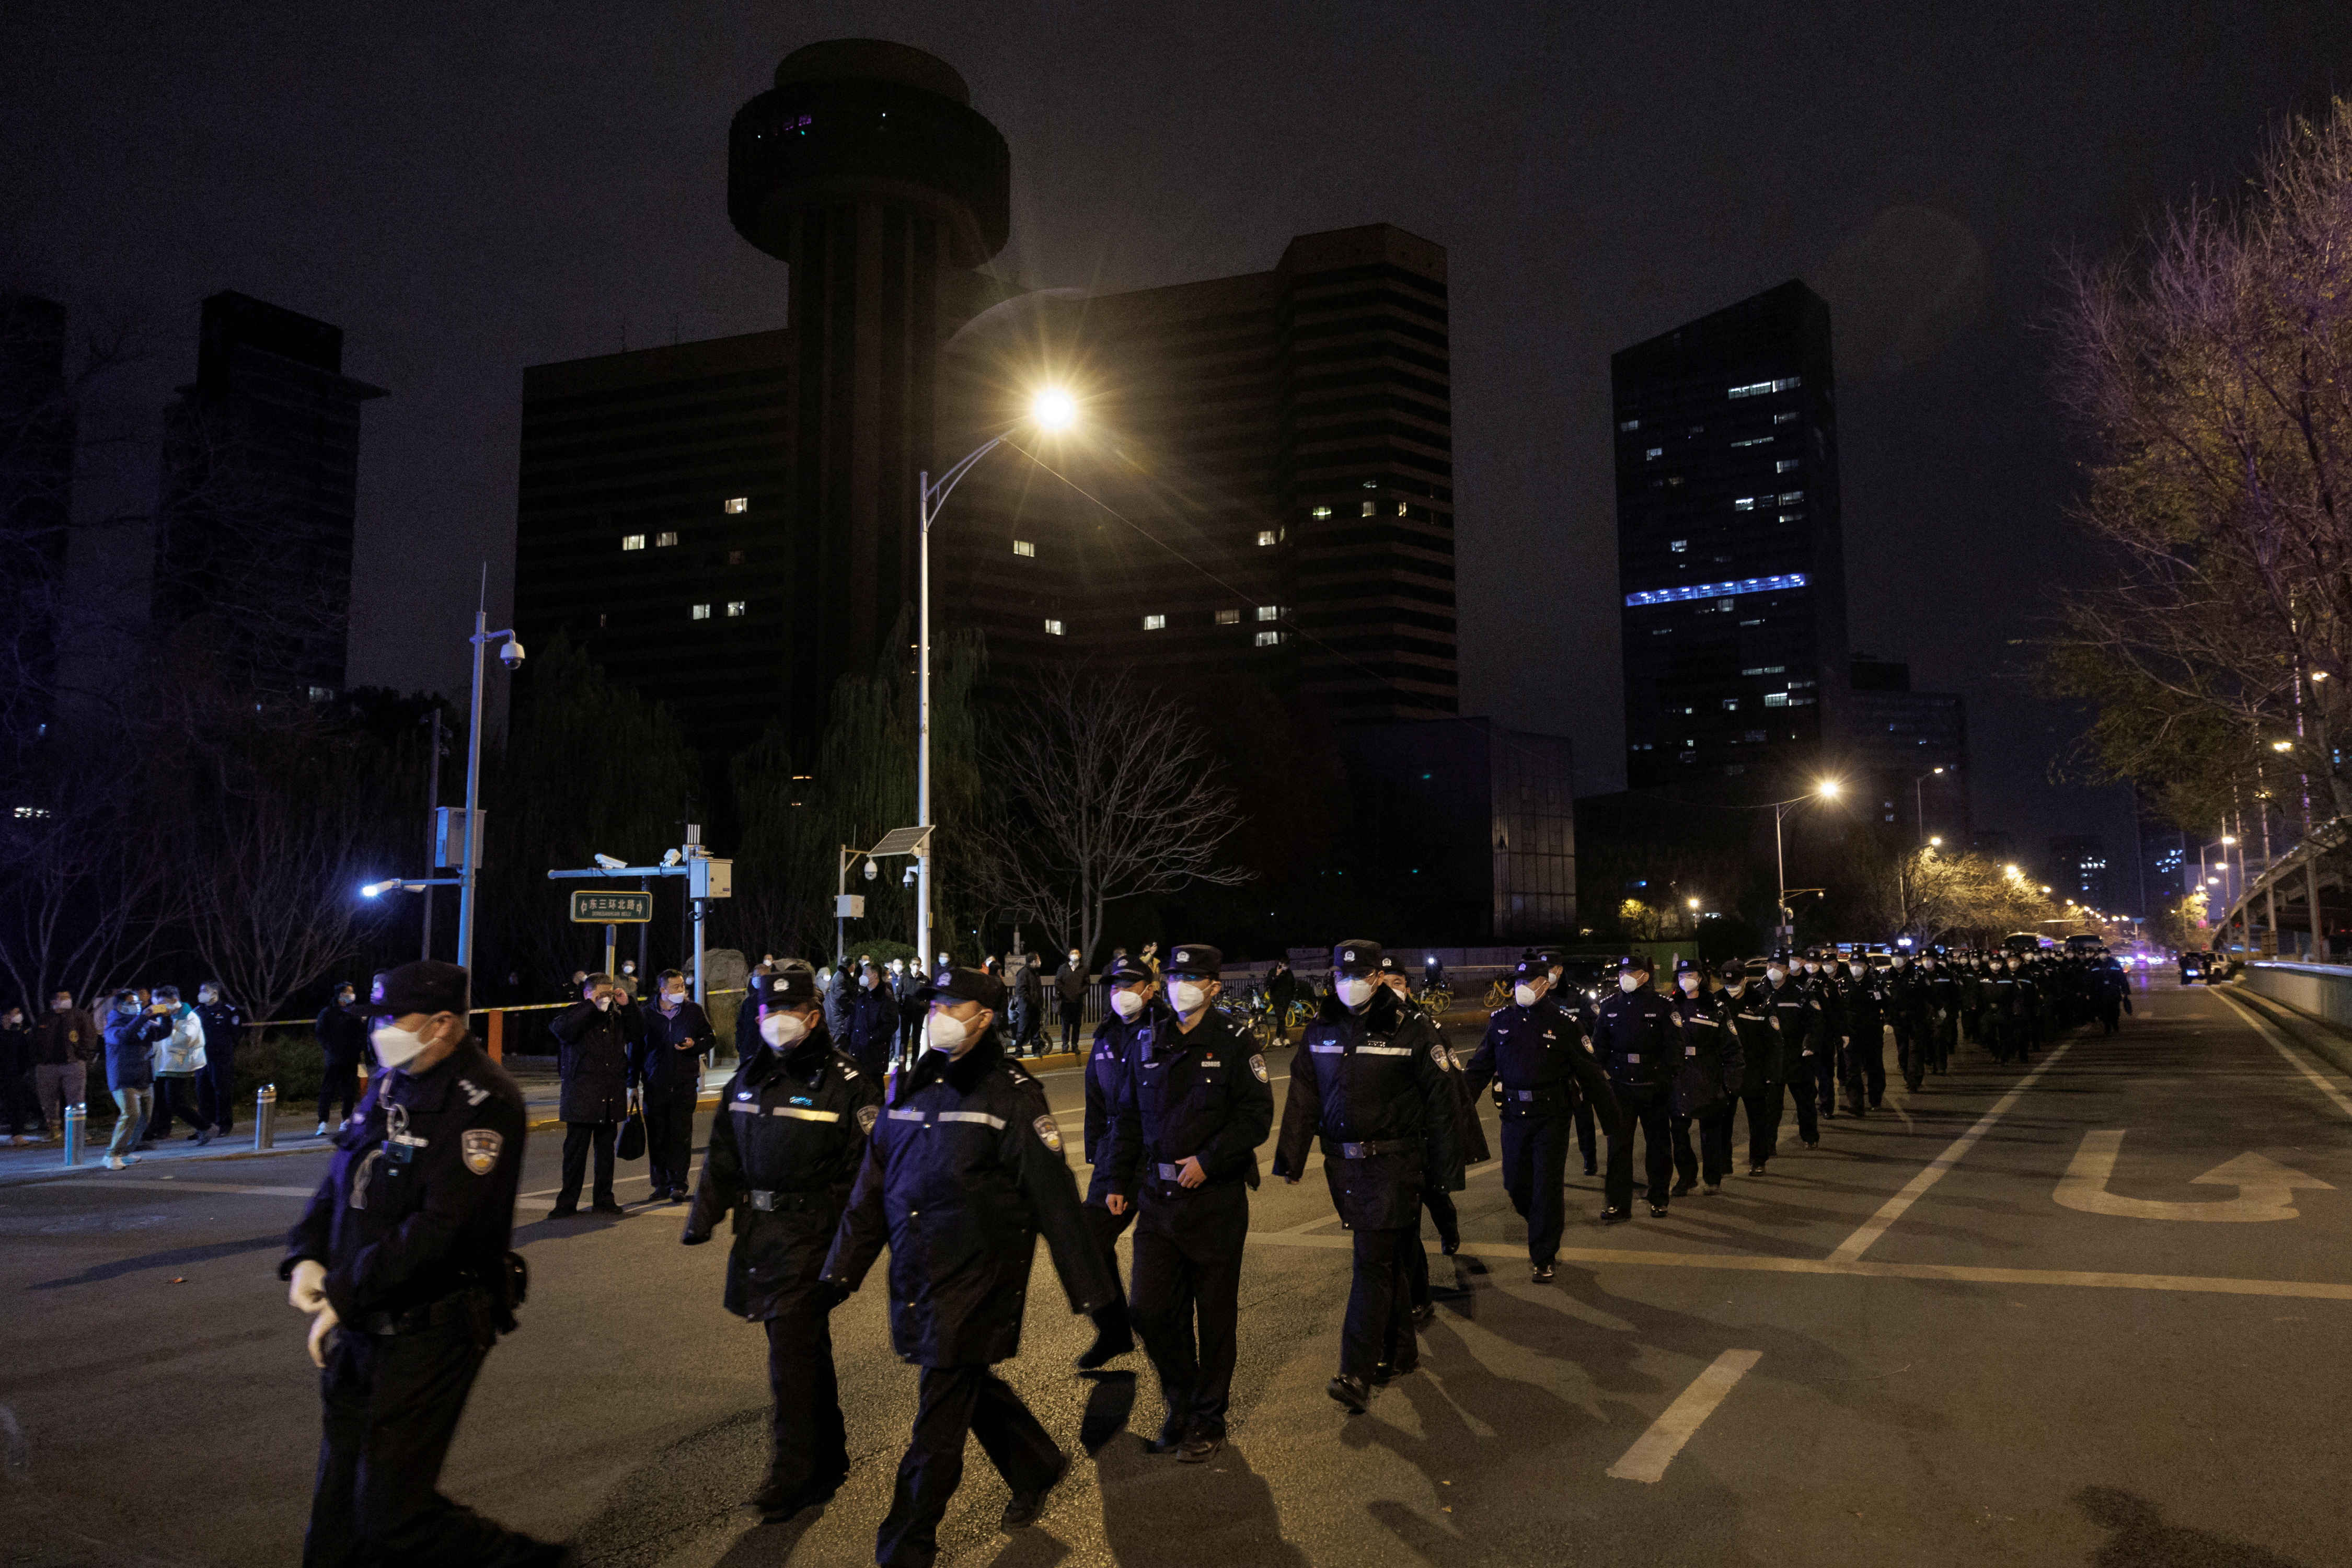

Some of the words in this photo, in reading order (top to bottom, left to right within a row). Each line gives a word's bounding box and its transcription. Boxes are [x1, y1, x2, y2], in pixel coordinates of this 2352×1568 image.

[590, 898, 635, 910] 东三环北路
